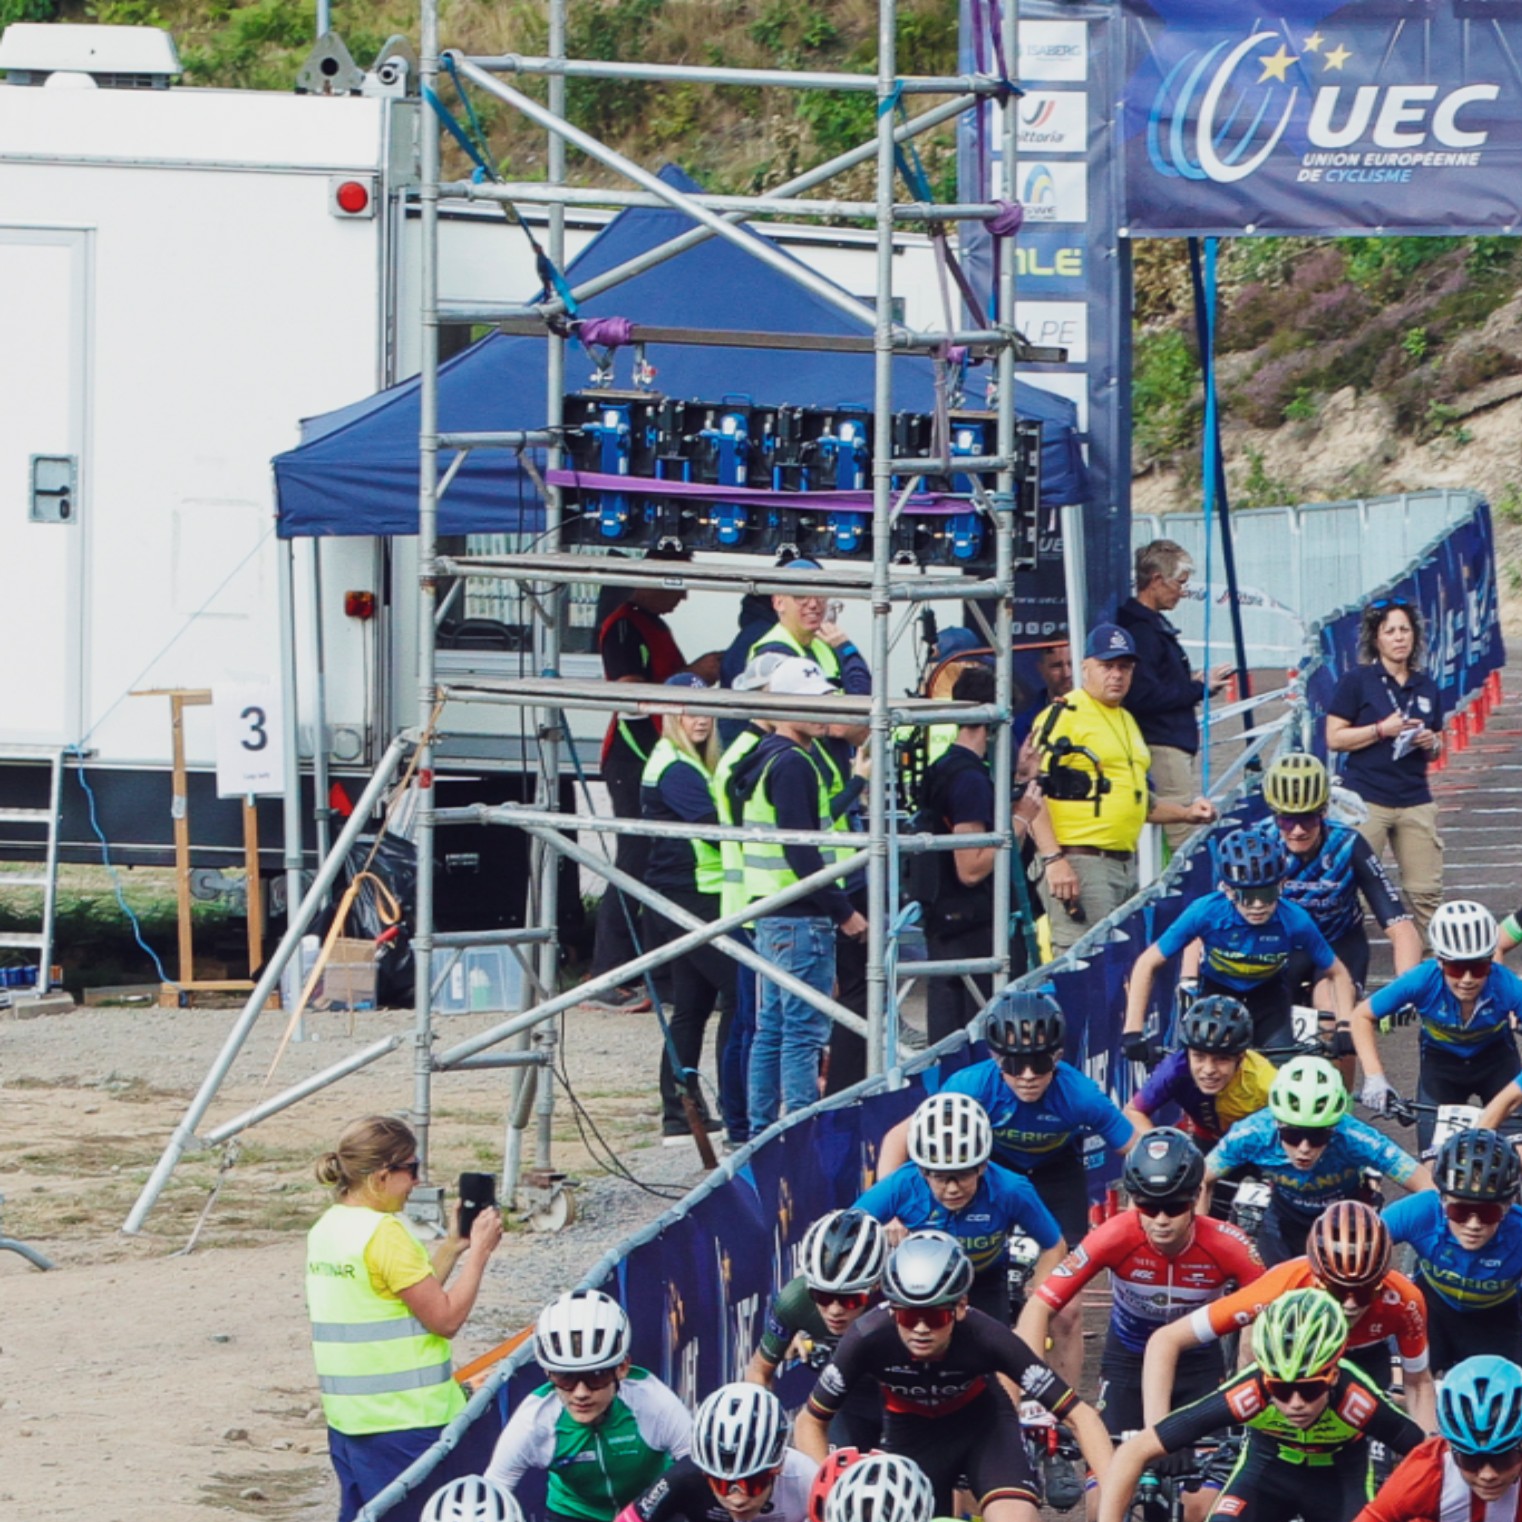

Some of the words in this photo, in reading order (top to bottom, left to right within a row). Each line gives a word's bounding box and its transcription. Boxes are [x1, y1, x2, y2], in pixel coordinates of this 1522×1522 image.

[1306, 84, 1500, 148] UEC
[1016, 130, 1065, 143] ittoria
[1302, 153, 1357, 168] UNION
[1297, 170, 1321, 183] DE
[1325, 168, 1411, 184] CYCLISME
[240, 705, 268, 752] 3
